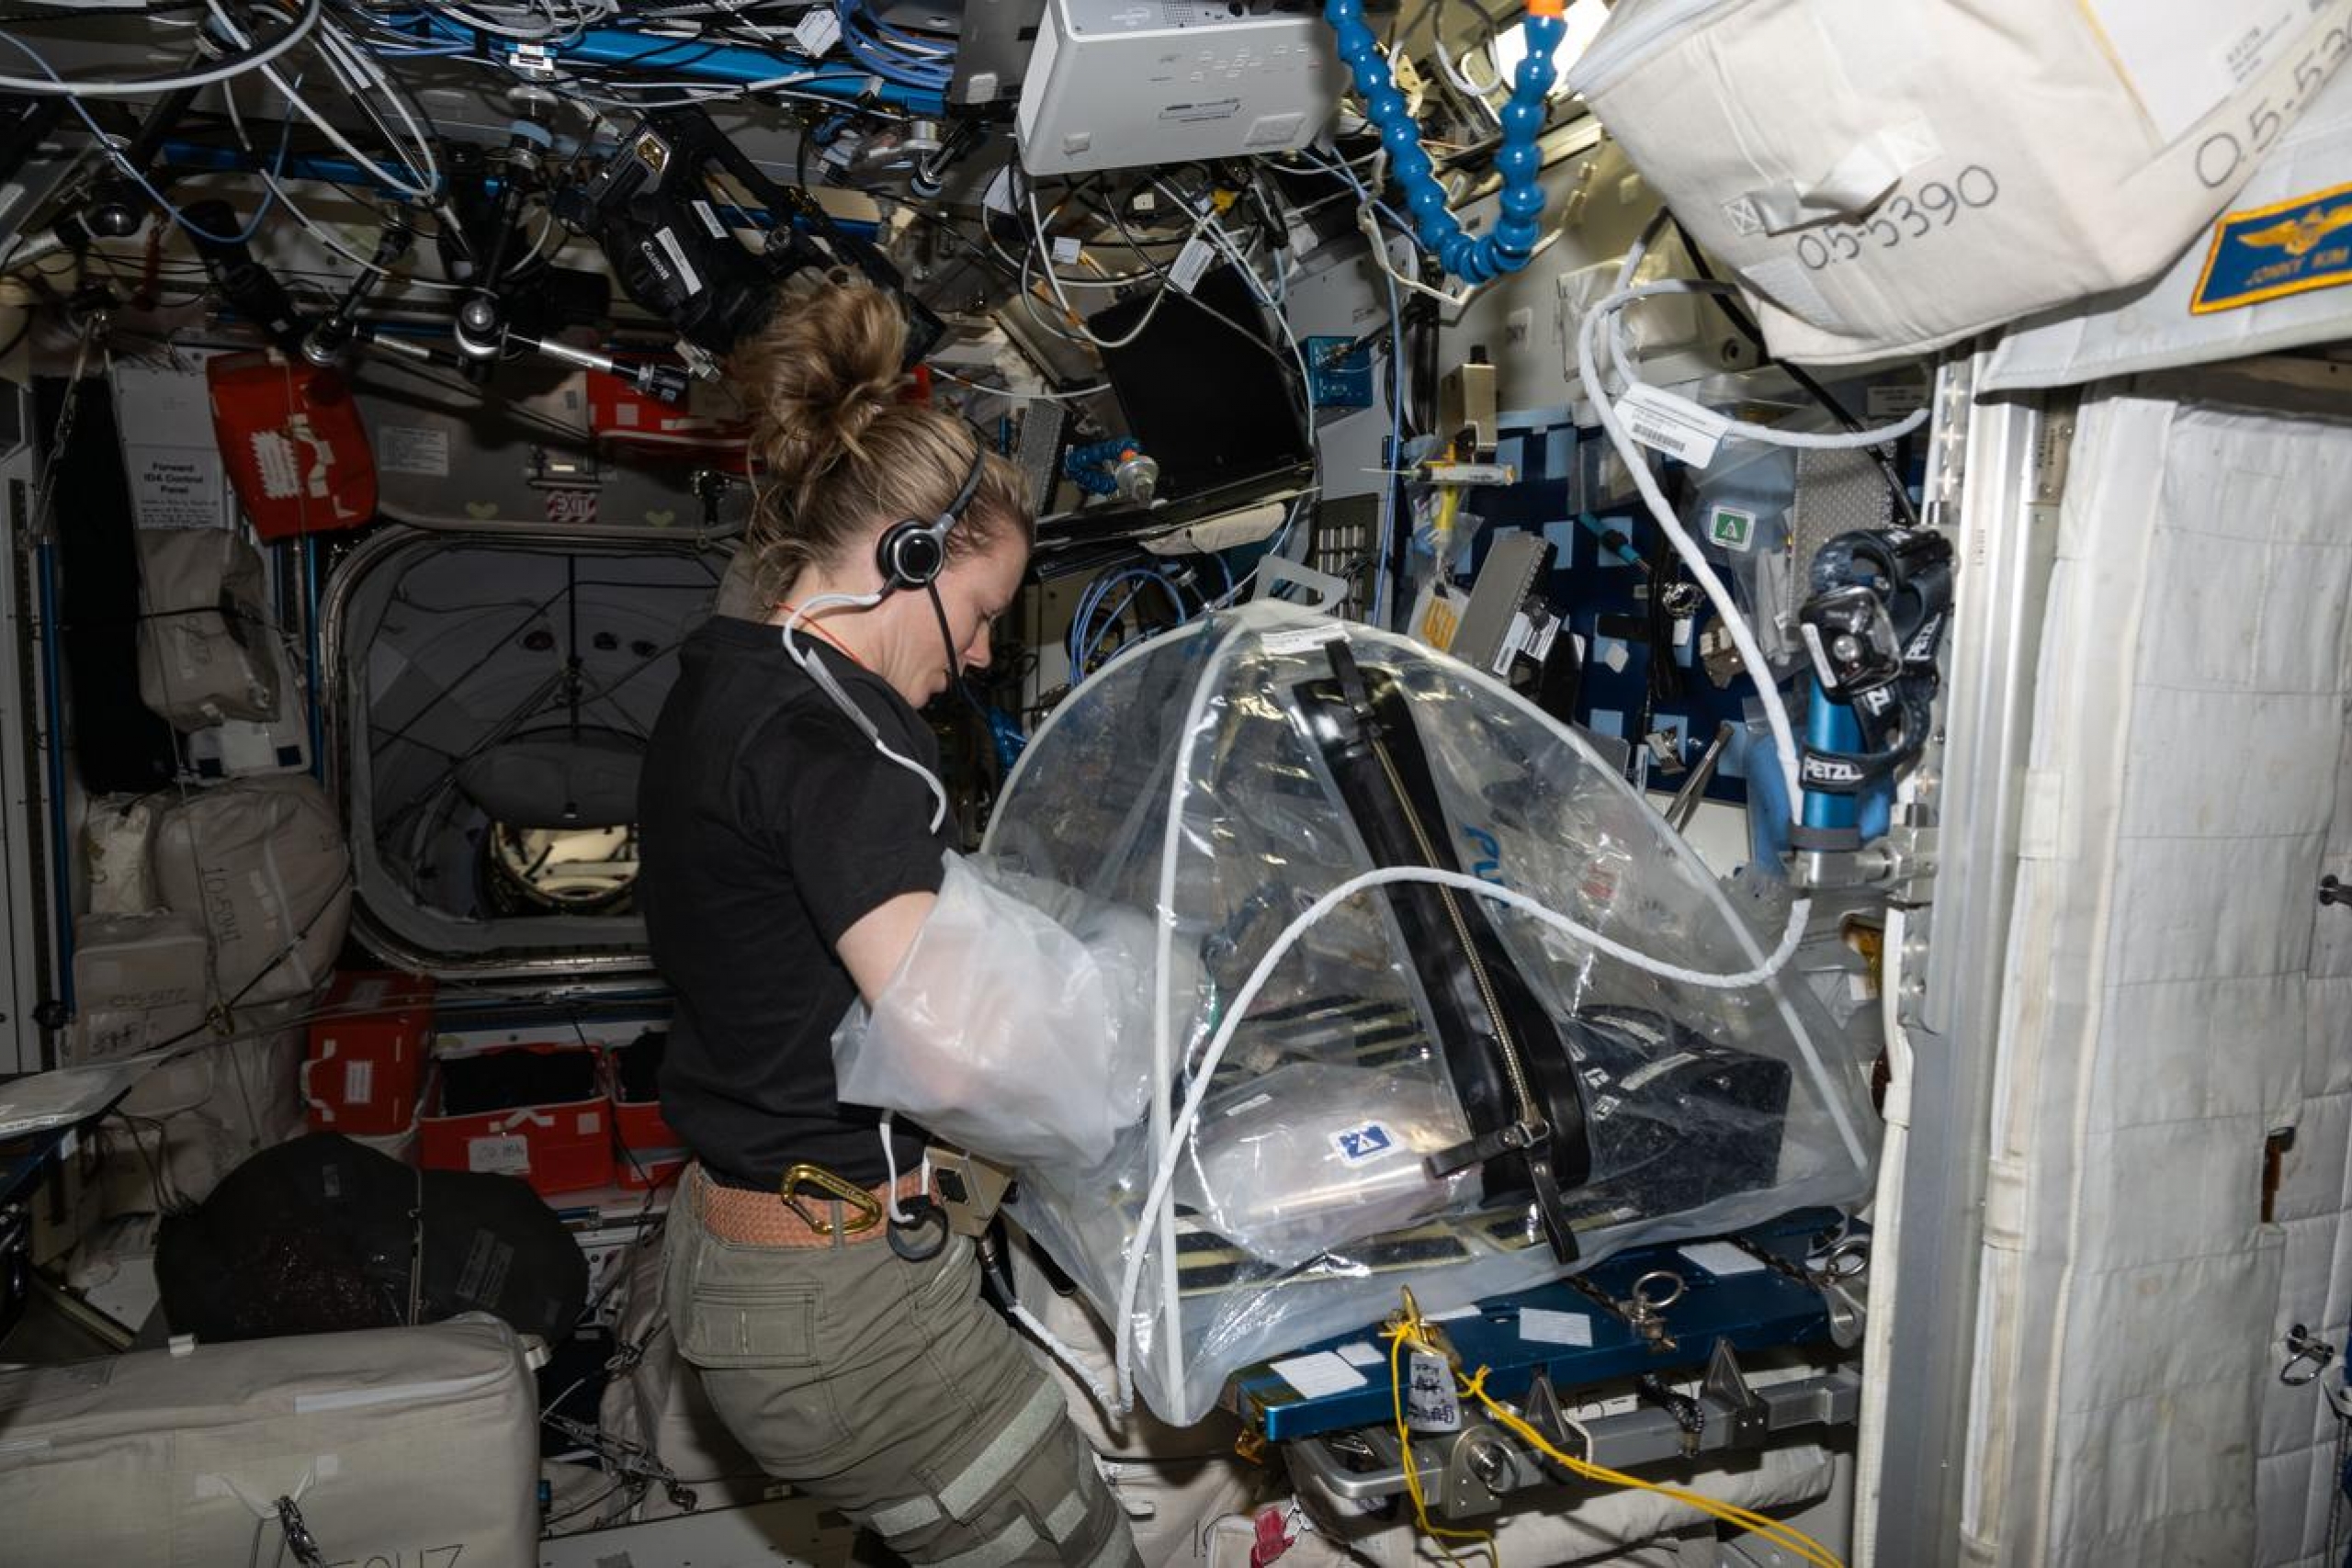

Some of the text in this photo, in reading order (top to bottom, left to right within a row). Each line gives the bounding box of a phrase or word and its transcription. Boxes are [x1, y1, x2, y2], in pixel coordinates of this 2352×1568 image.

[640, 241, 670, 280] Canon
[165, 474, 204, 484] Control
[555, 492, 589, 513] EXIT
[1804, 755, 1864, 781] PETZL
